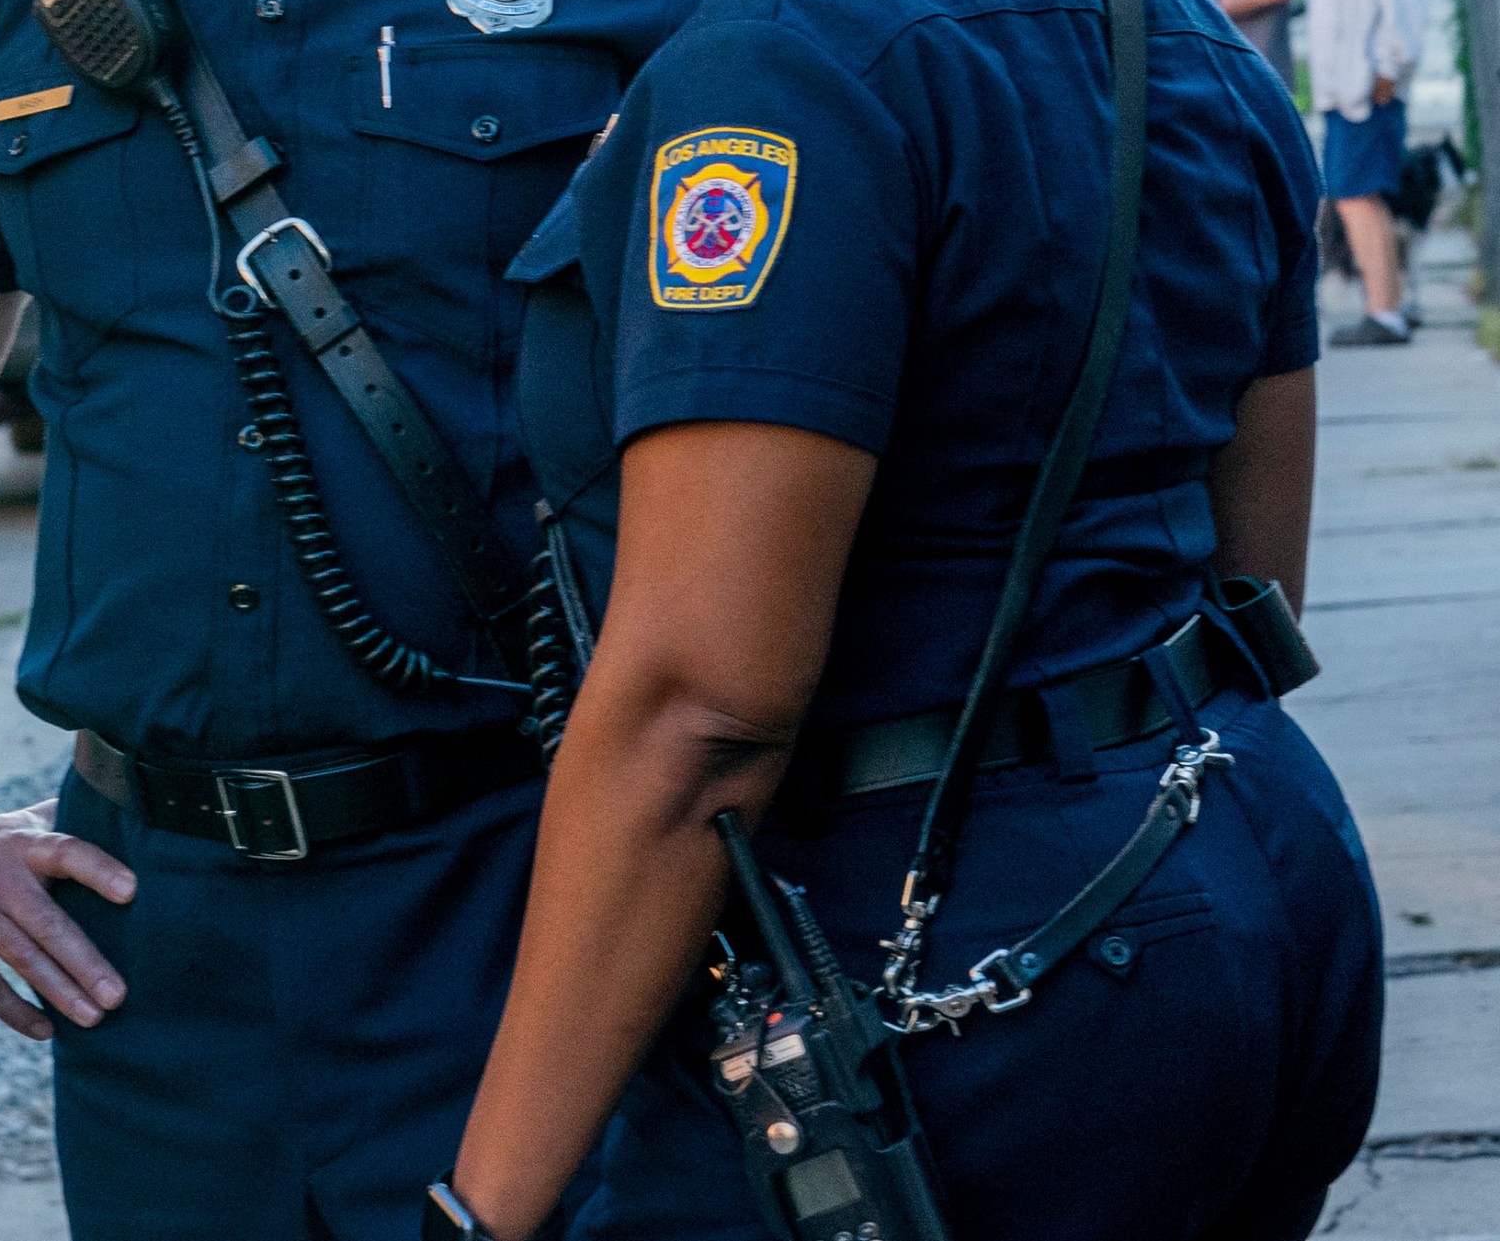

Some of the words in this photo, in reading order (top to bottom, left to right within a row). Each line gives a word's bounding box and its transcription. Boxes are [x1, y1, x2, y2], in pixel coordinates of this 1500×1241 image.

[697, 138, 791, 166] ANGELES
[664, 286, 697, 301] FIRE
[700, 285, 747, 301] DEPT
